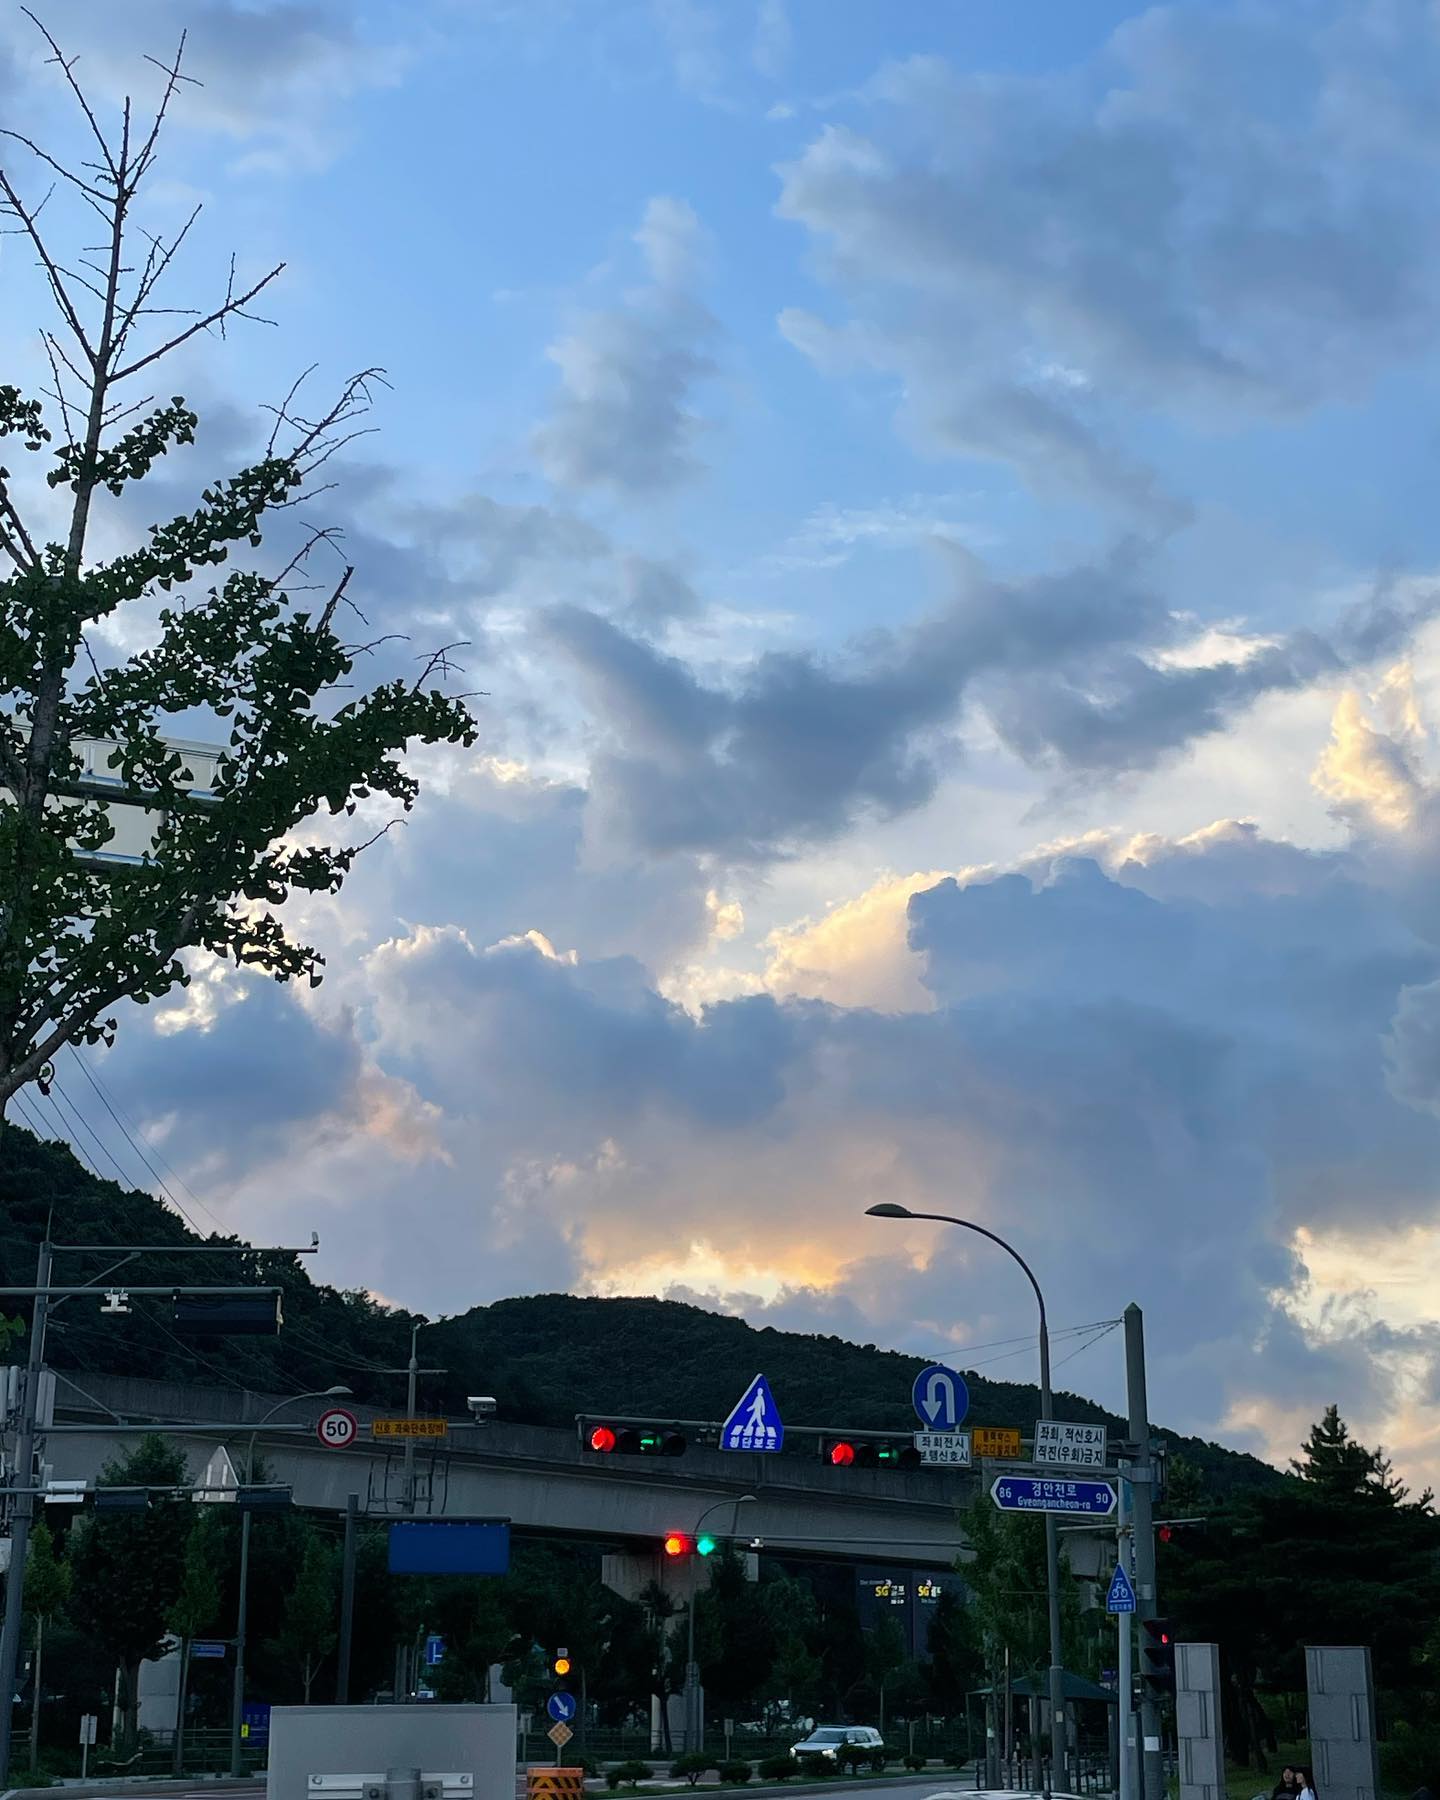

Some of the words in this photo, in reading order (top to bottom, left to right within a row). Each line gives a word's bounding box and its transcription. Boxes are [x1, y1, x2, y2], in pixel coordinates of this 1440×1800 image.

[326, 1421, 348, 1437] 50
[1065, 1427, 1103, 1445] 적신호시
[729, 1436, 776, 1450] 횡단보도
[921, 1436, 964, 1449] 좌회전시
[1038, 1445, 1103, 1464] 직진(우회)금지
[999, 1487, 1012, 1498] 86
[1031, 1482, 1077, 1498] 경안천로
[1017, 1496, 1091, 1510] Gyeongancheon-ro
[1095, 1493, 1108, 1504] 90
